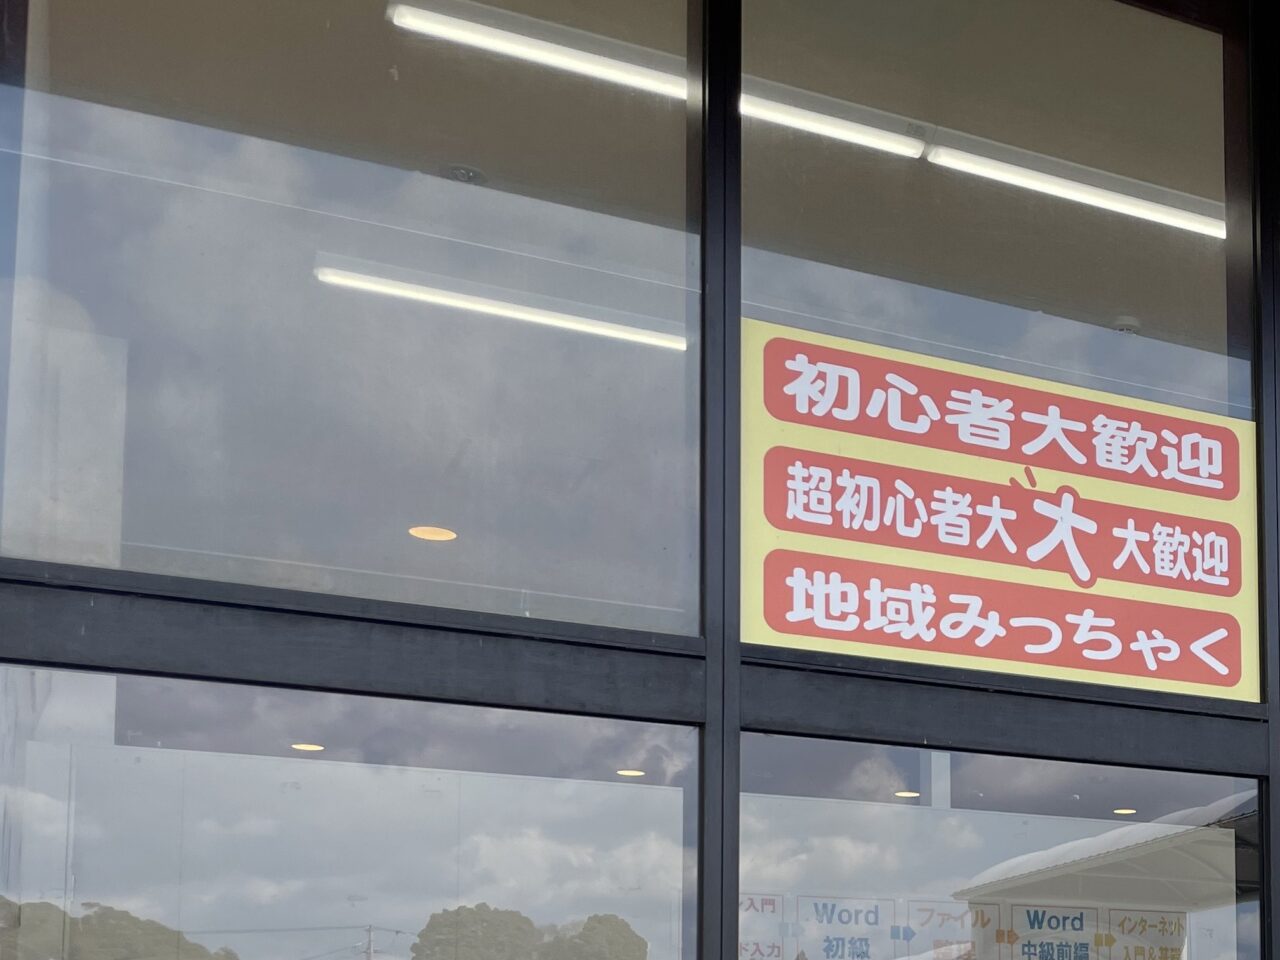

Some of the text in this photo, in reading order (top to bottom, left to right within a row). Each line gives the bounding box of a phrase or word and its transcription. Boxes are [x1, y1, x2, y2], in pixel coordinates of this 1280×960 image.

[783, 353, 1224, 489] 初心者大歓迎
[786, 567, 1229, 675] 地域みっちゃく
[814, 903, 879, 926] Word
[1027, 909, 1084, 932] Word
[1118, 915, 1184, 936] インターネット
[822, 936, 871, 960] 初級
